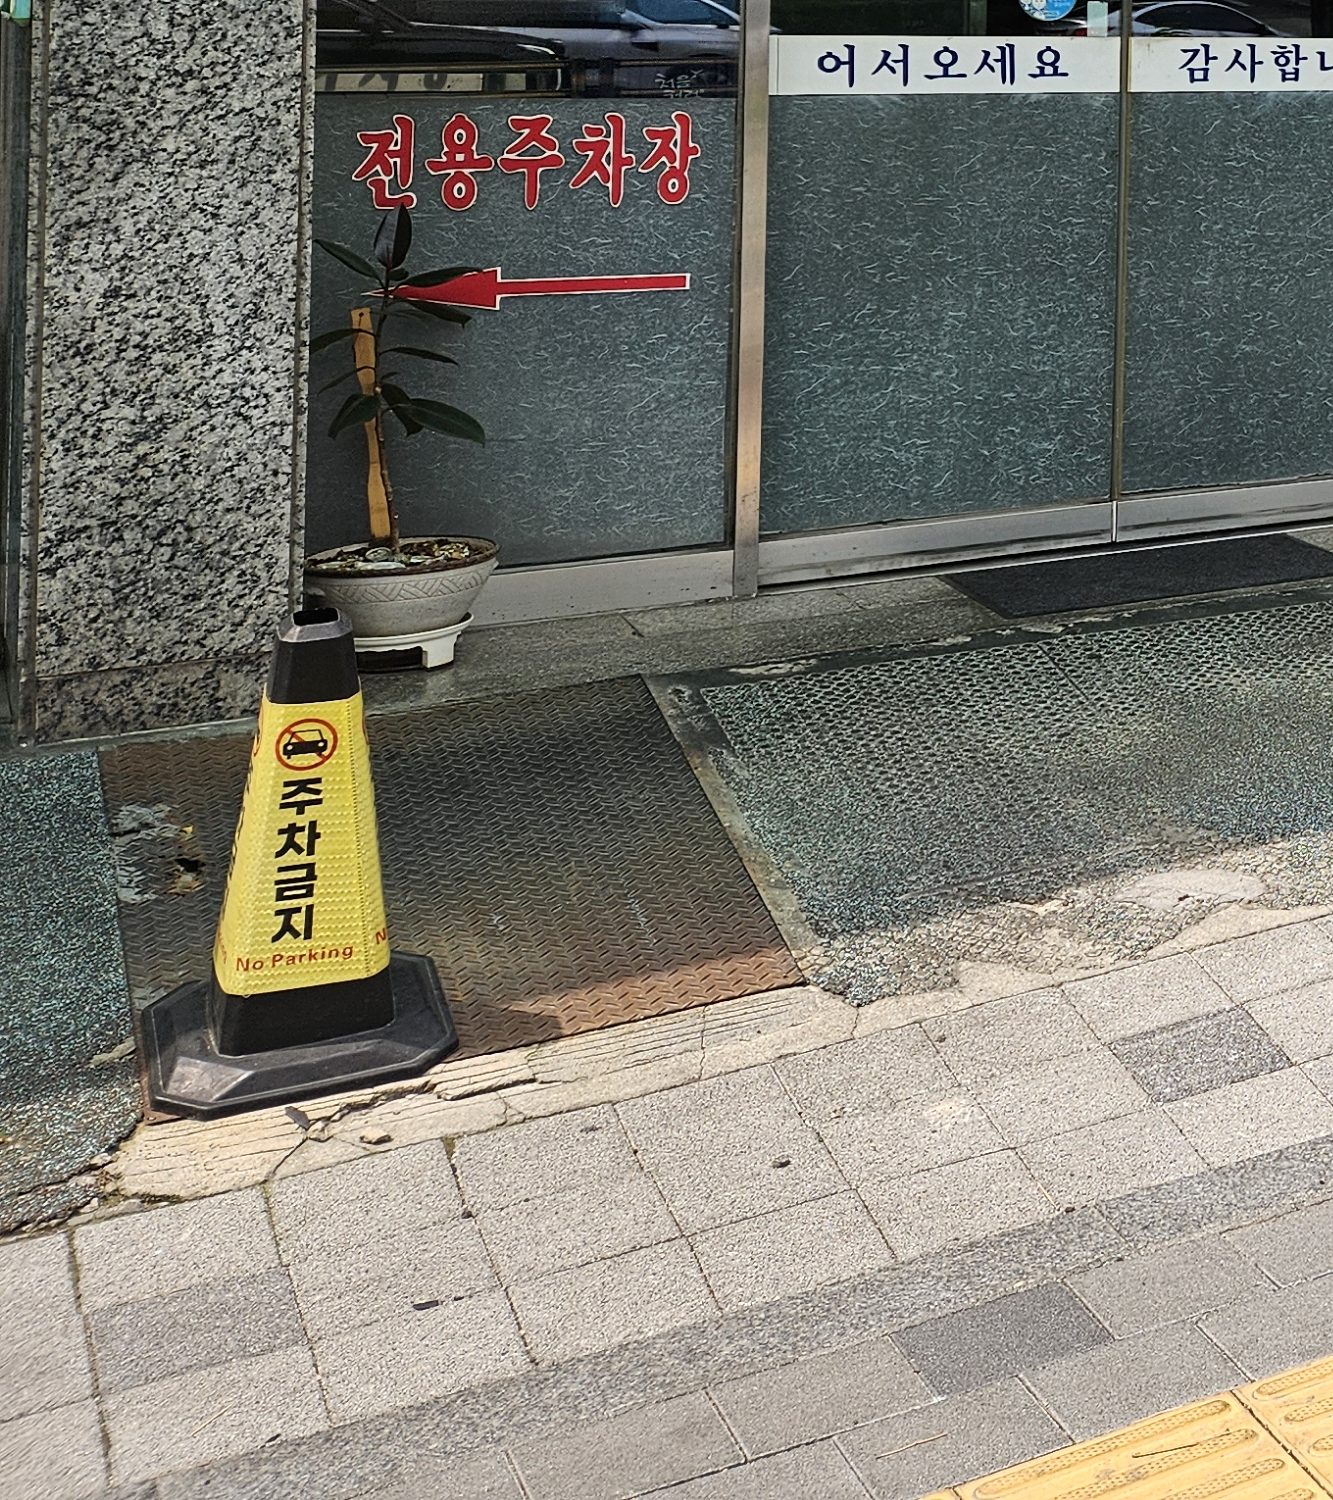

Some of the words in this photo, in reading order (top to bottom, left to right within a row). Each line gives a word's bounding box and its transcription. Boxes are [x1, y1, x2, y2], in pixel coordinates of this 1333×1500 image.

[816, 45, 1069, 87] 어서오세요
[351, 111, 701, 211] 전용주차장
[271, 777, 323, 943] 주차금지
[235, 957, 265, 972] No
[271, 945, 354, 968] Parking
